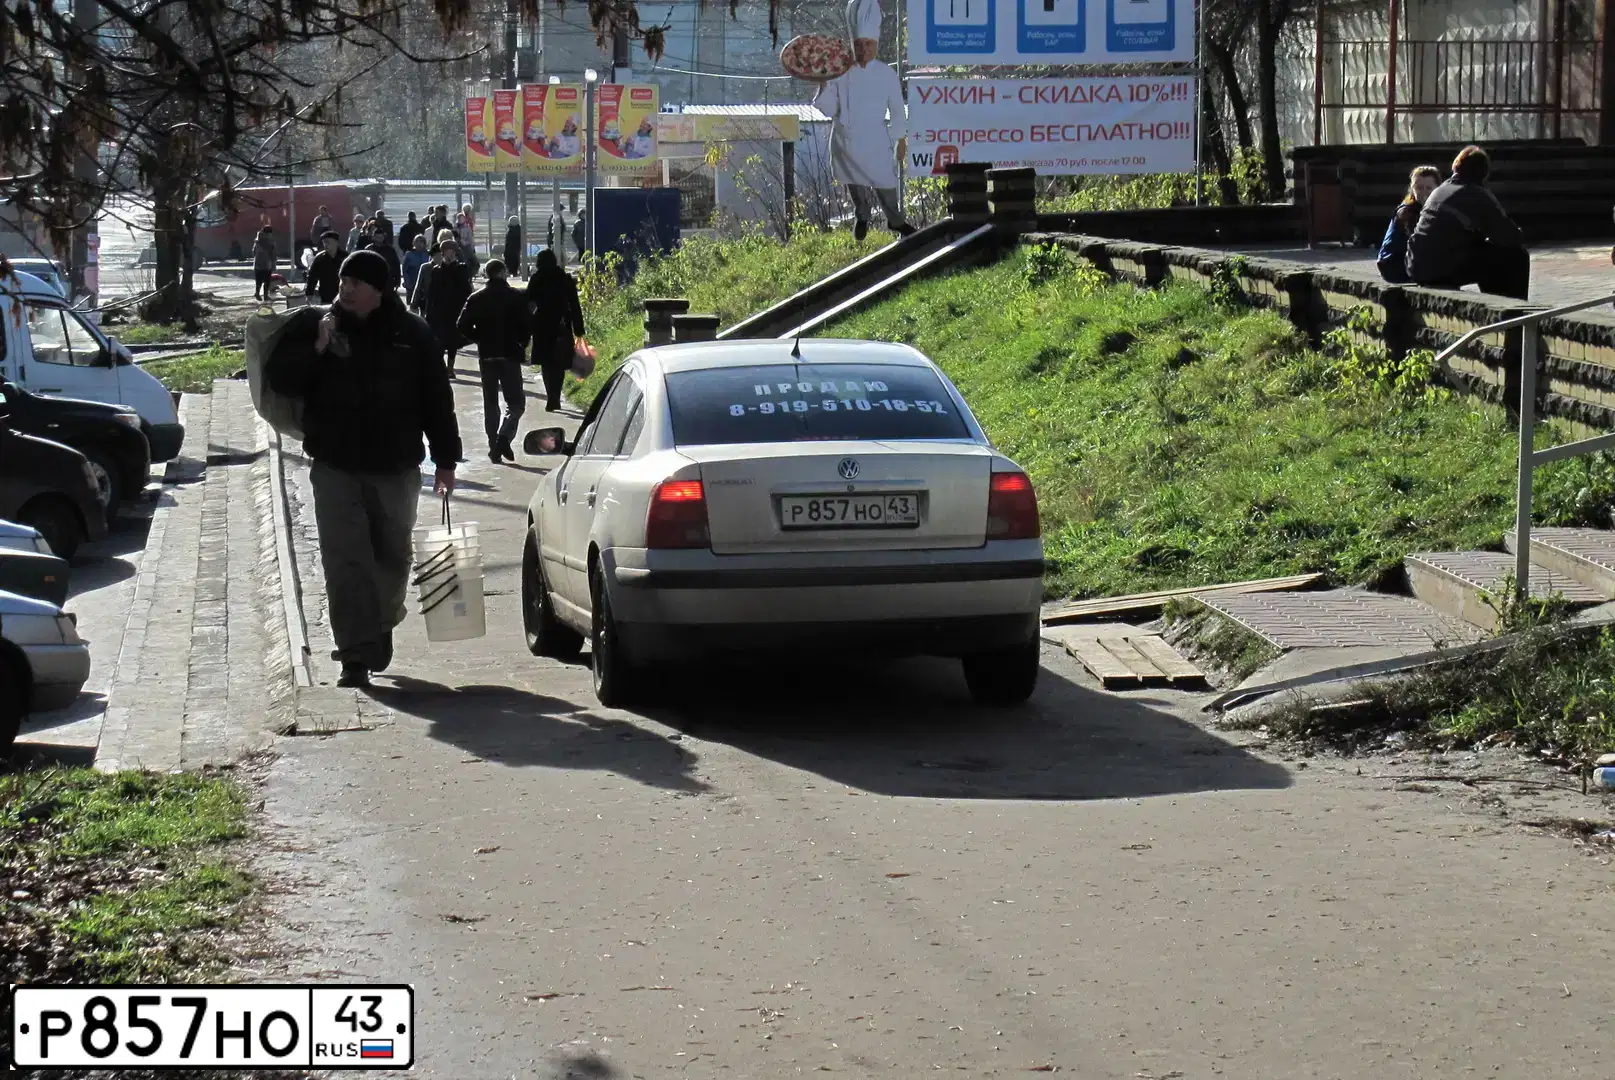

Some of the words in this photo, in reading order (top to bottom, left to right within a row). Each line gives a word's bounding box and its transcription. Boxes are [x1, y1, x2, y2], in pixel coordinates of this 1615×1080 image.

[916, 85, 996, 105] УЖИН
[1018, 84, 1123, 105] СКИДКА
[1127, 83, 1188, 103] 10%!!!
[925, 127, 1024, 147] эспрессо
[1030, 121, 1191, 143] БЕСПЛАТНО!!!
[1056, 157, 1068, 166] 70
[1091, 158, 1120, 167] после
[754, 380, 889, 396] ПРОДАЮ
[729, 398, 948, 417] 8-919-510-18-52
[888, 497, 910, 514] 43
